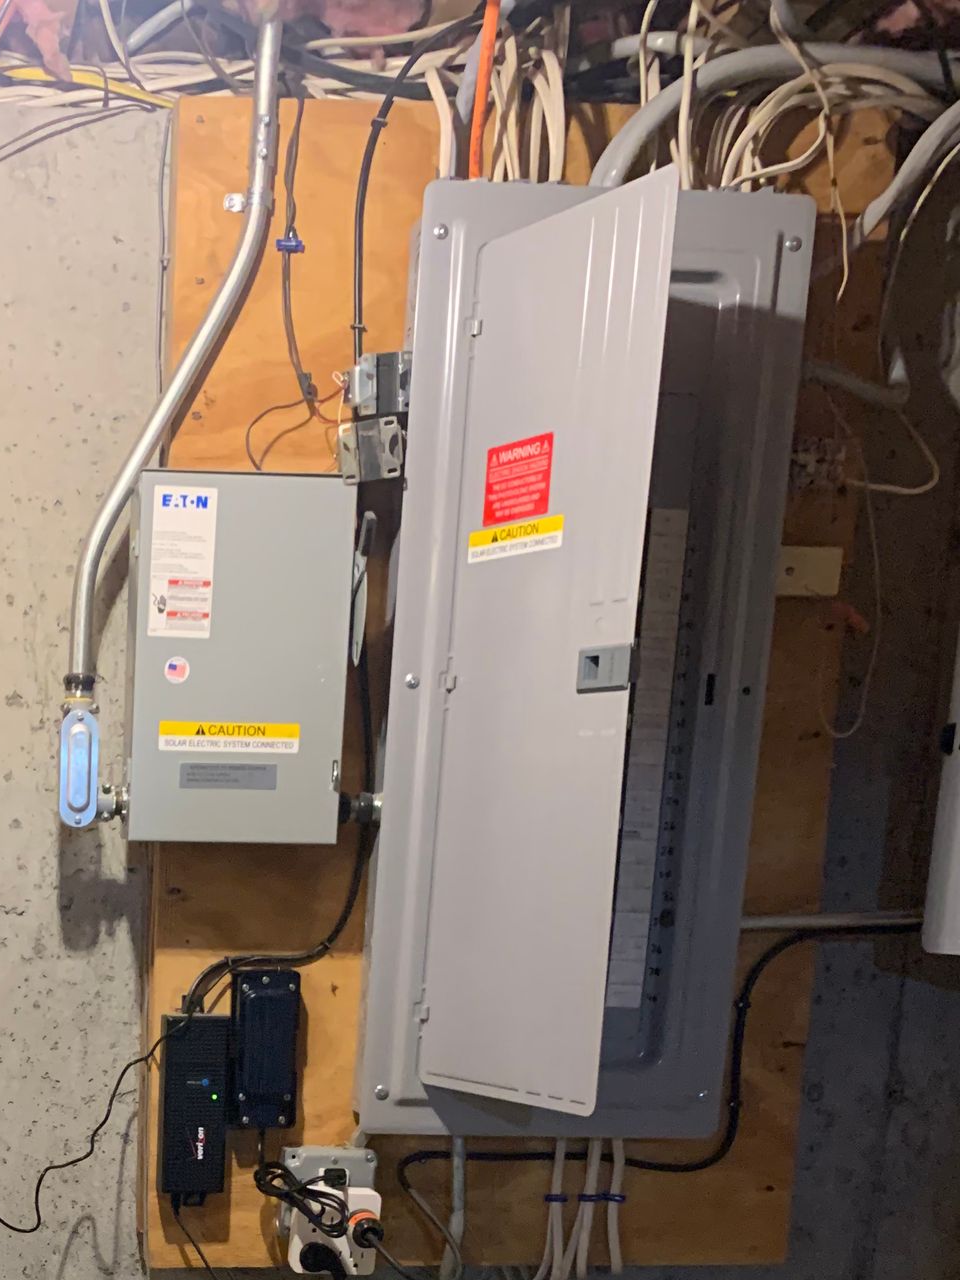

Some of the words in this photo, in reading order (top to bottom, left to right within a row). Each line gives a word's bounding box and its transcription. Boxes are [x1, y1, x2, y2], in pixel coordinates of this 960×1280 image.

[498, 442, 541, 464] WARNING
[499, 523, 539, 541] CAUTION
[208, 724, 266, 737] CAUTION
[164, 739, 187, 747] SOLAR
[188, 740, 220, 748] ELECTRIC
[223, 740, 251, 749] SYSTEM
[252, 740, 294, 749] CONNECTED
[195, 1126, 206, 1160] verizon
